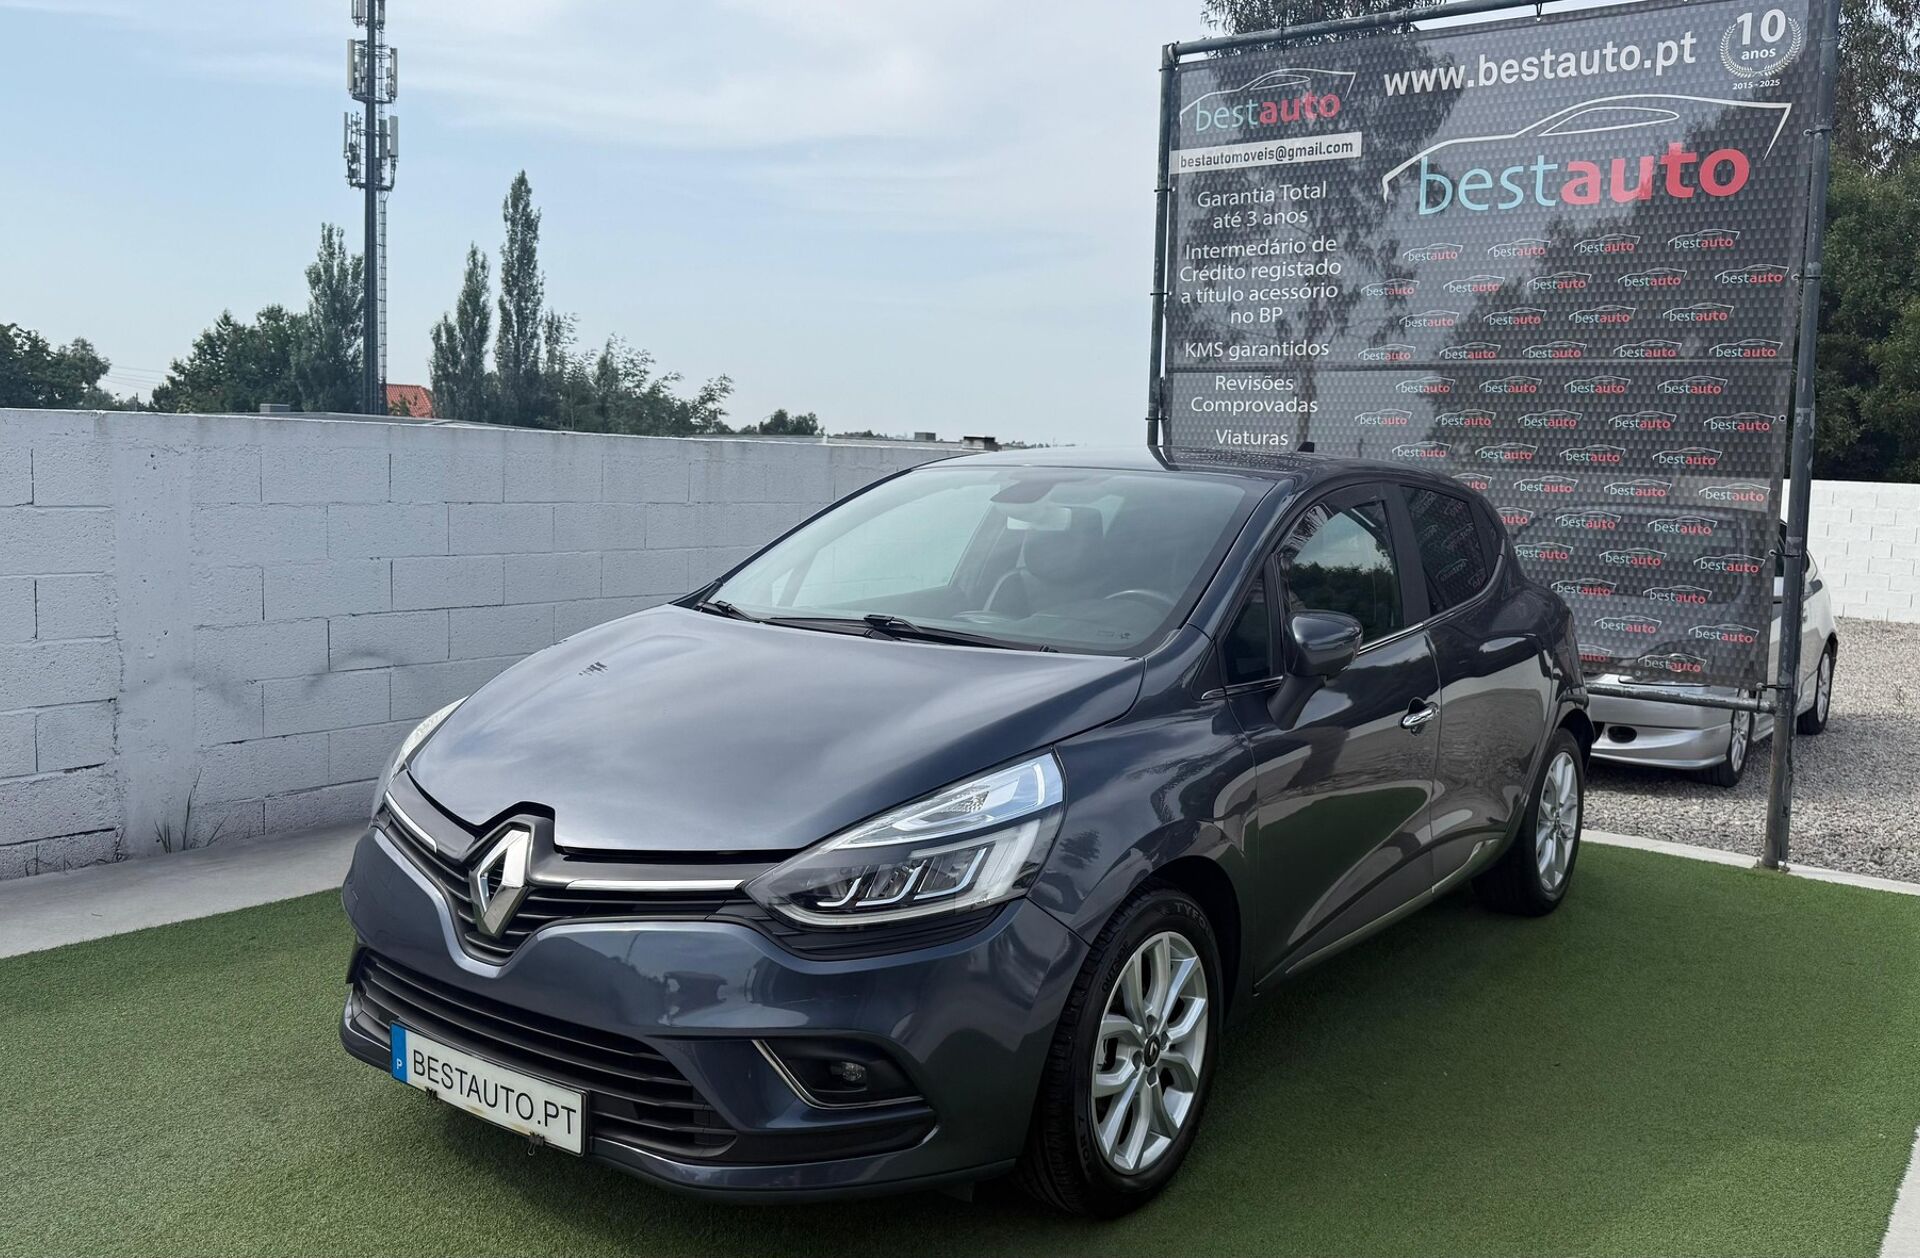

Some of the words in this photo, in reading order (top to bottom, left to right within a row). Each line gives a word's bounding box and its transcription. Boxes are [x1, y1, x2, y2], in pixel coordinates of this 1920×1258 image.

[1736, 8, 1786, 45] 10
[1742, 46, 1776, 60] anos
[1384, 30, 1697, 97] www.bestauto.pt
[1196, 92, 1341, 132] bestauto
[1180, 141, 1353, 169] bestautomoveis@gmail.com
[1418, 142, 1750, 215] bestauto
[1198, 184, 1275, 208] Garantia
[1280, 181, 1327, 201] Total
[1213, 211, 1241, 229] até
[1246, 211, 1258, 227] 3
[1264, 210, 1308, 225] anos
[1185, 240, 1306, 260] Intermedário
[1312, 235, 1336, 252] de
[1580, 241, 1635, 253] bestauto
[1675, 236, 1734, 249] bestauto
[1407, 248, 1458, 262] bestauto
[1493, 244, 1546, 257] bestauto
[1180, 266, 1246, 282] Crédito
[1251, 259, 1341, 282] registado
[1533, 278, 1586, 290] bestauto
[1624, 274, 1681, 287] bestauto
[1721, 271, 1783, 284] bestauto
[1181, 293, 1192, 304] a
[1196, 287, 1244, 302] título
[1249, 283, 1338, 301] acessório
[1366, 284, 1414, 296] bestauto
[1449, 281, 1501, 294] bestauto
[1231, 310, 1253, 323] no
[1260, 307, 1283, 322] BP
[1404, 315, 1454, 327] bestauto
[1489, 313, 1541, 326] bestauto
[1574, 311, 1630, 324] bestauto
[1669, 309, 1727, 322] bestauto
[1185, 342, 1224, 358] KMS
[1229, 340, 1329, 361] garantidos
[1362, 349, 1411, 361] bestauto
[1444, 348, 1496, 360] bestauto
[1528, 347, 1581, 359] bestauto
[1619, 345, 1676, 358] bestauto
[1716, 345, 1776, 358] bestauto
[1215, 375, 1294, 391] Revisões
[1401, 381, 1450, 393] bestauto
[1485, 382, 1537, 394] bestauto
[1570, 381, 1625, 394] bestauto
[1664, 382, 1721, 394] bestauto
[1191, 397, 1318, 415] Comprovadas
[1360, 414, 1407, 426] bestauto
[1440, 415, 1491, 426] bestauto
[1524, 416, 1576, 428] bestauto
[1614, 417, 1671, 429] bestauto
[1710, 419, 1770, 431] bestauto
[1216, 429, 1288, 446] Viaturas
[1397, 448, 1446, 458] bestauto
[1481, 450, 1532, 460] bestauto
[1566, 450, 1620, 463] bestauto
[1659, 452, 1716, 466] bestauto
[1520, 481, 1574, 494] bestauto
[1609, 484, 1666, 497] bestauto
[1705, 488, 1764, 502] bestauto
[1561, 516, 1616, 530] bestauto
[1654, 521, 1712, 535] bestauto
[1516, 546, 1568, 560] bestauto
[1605, 551, 1661, 566] bestauto
[1700, 558, 1759, 573] bestauto
[1556, 582, 1612, 596] bestauto
[1650, 587, 1706, 604] bestauto
[1601, 619, 1656, 634] bestauto
[1695, 627, 1753, 643] bestauto
[1644, 657, 1701, 673] bestauto
[396, 1059, 403, 1070] P
[413, 1049, 576, 1135] BESTAUTO.PT
